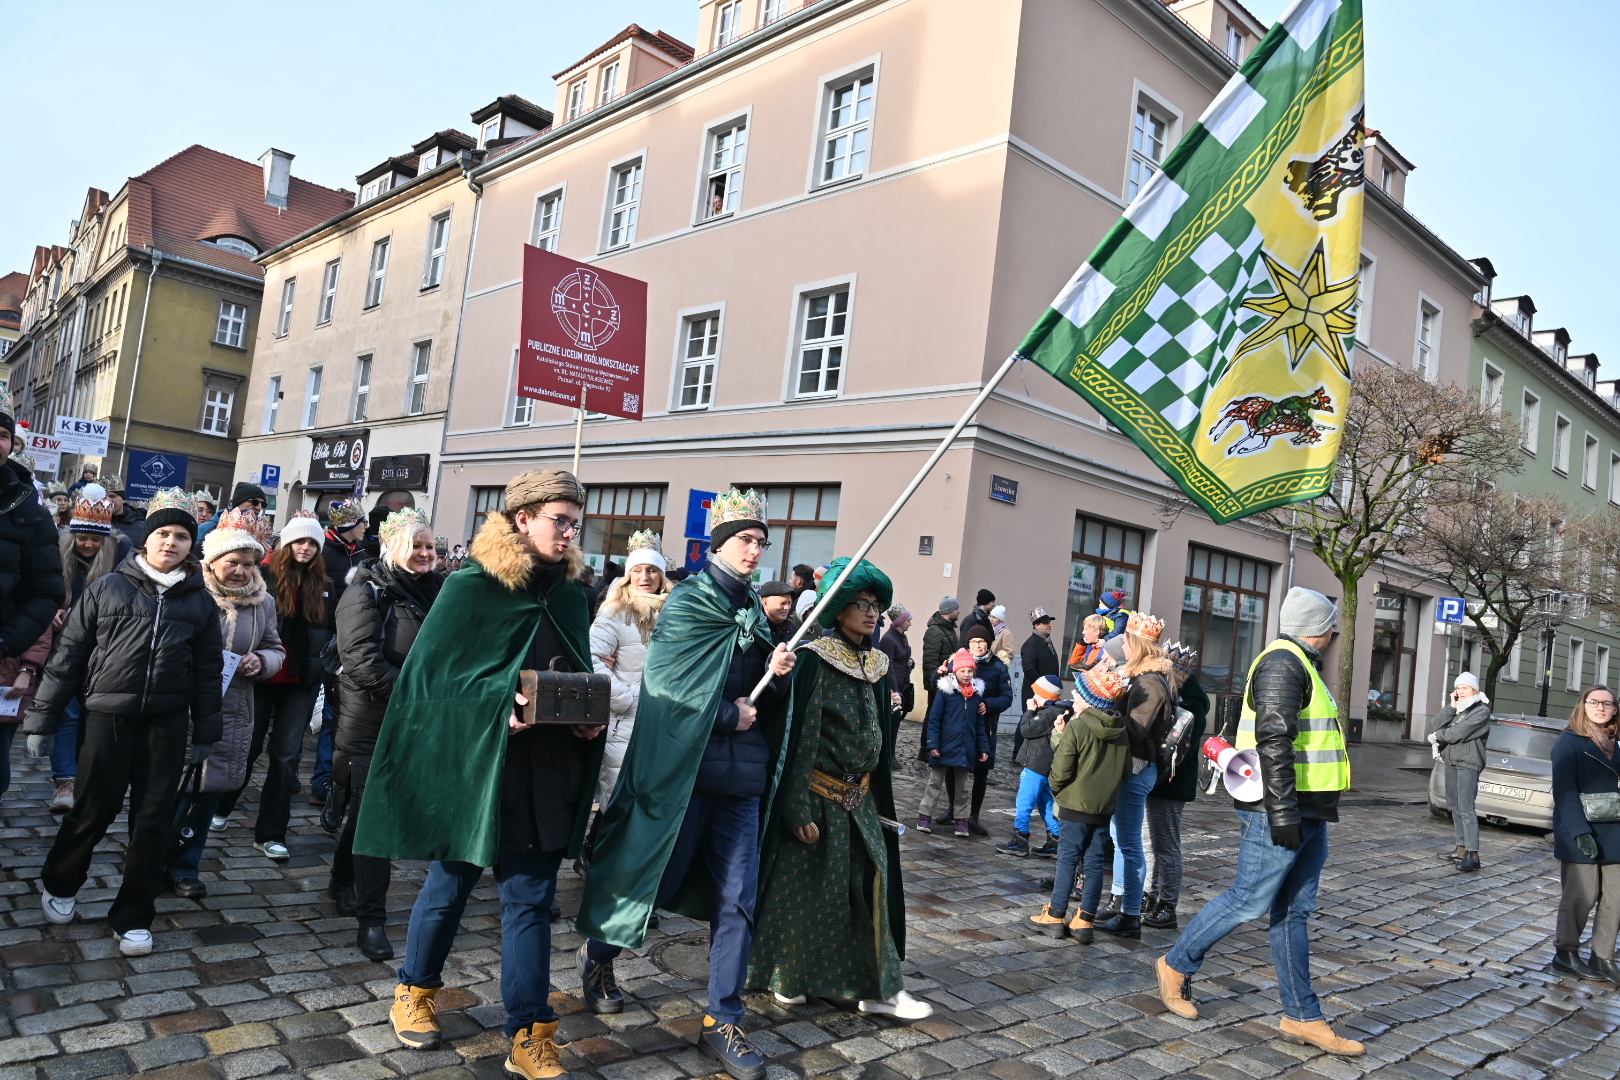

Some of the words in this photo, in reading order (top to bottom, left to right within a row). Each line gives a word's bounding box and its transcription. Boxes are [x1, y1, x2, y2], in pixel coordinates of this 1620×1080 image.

[528, 339, 560, 356] PUBLICZNE
[562, 348, 582, 361] LICEUM
[584, 352, 639, 375] OGÓLNOKSZTAŁCĄCE
[536, 355, 564, 367] Katolickiego
[565, 362, 598, 374] Stowarzyszenia
[524, 385, 576, 402] www.dobreliceum.pl
[266, 466, 276, 480] P
[1442, 600, 1458, 619] P
